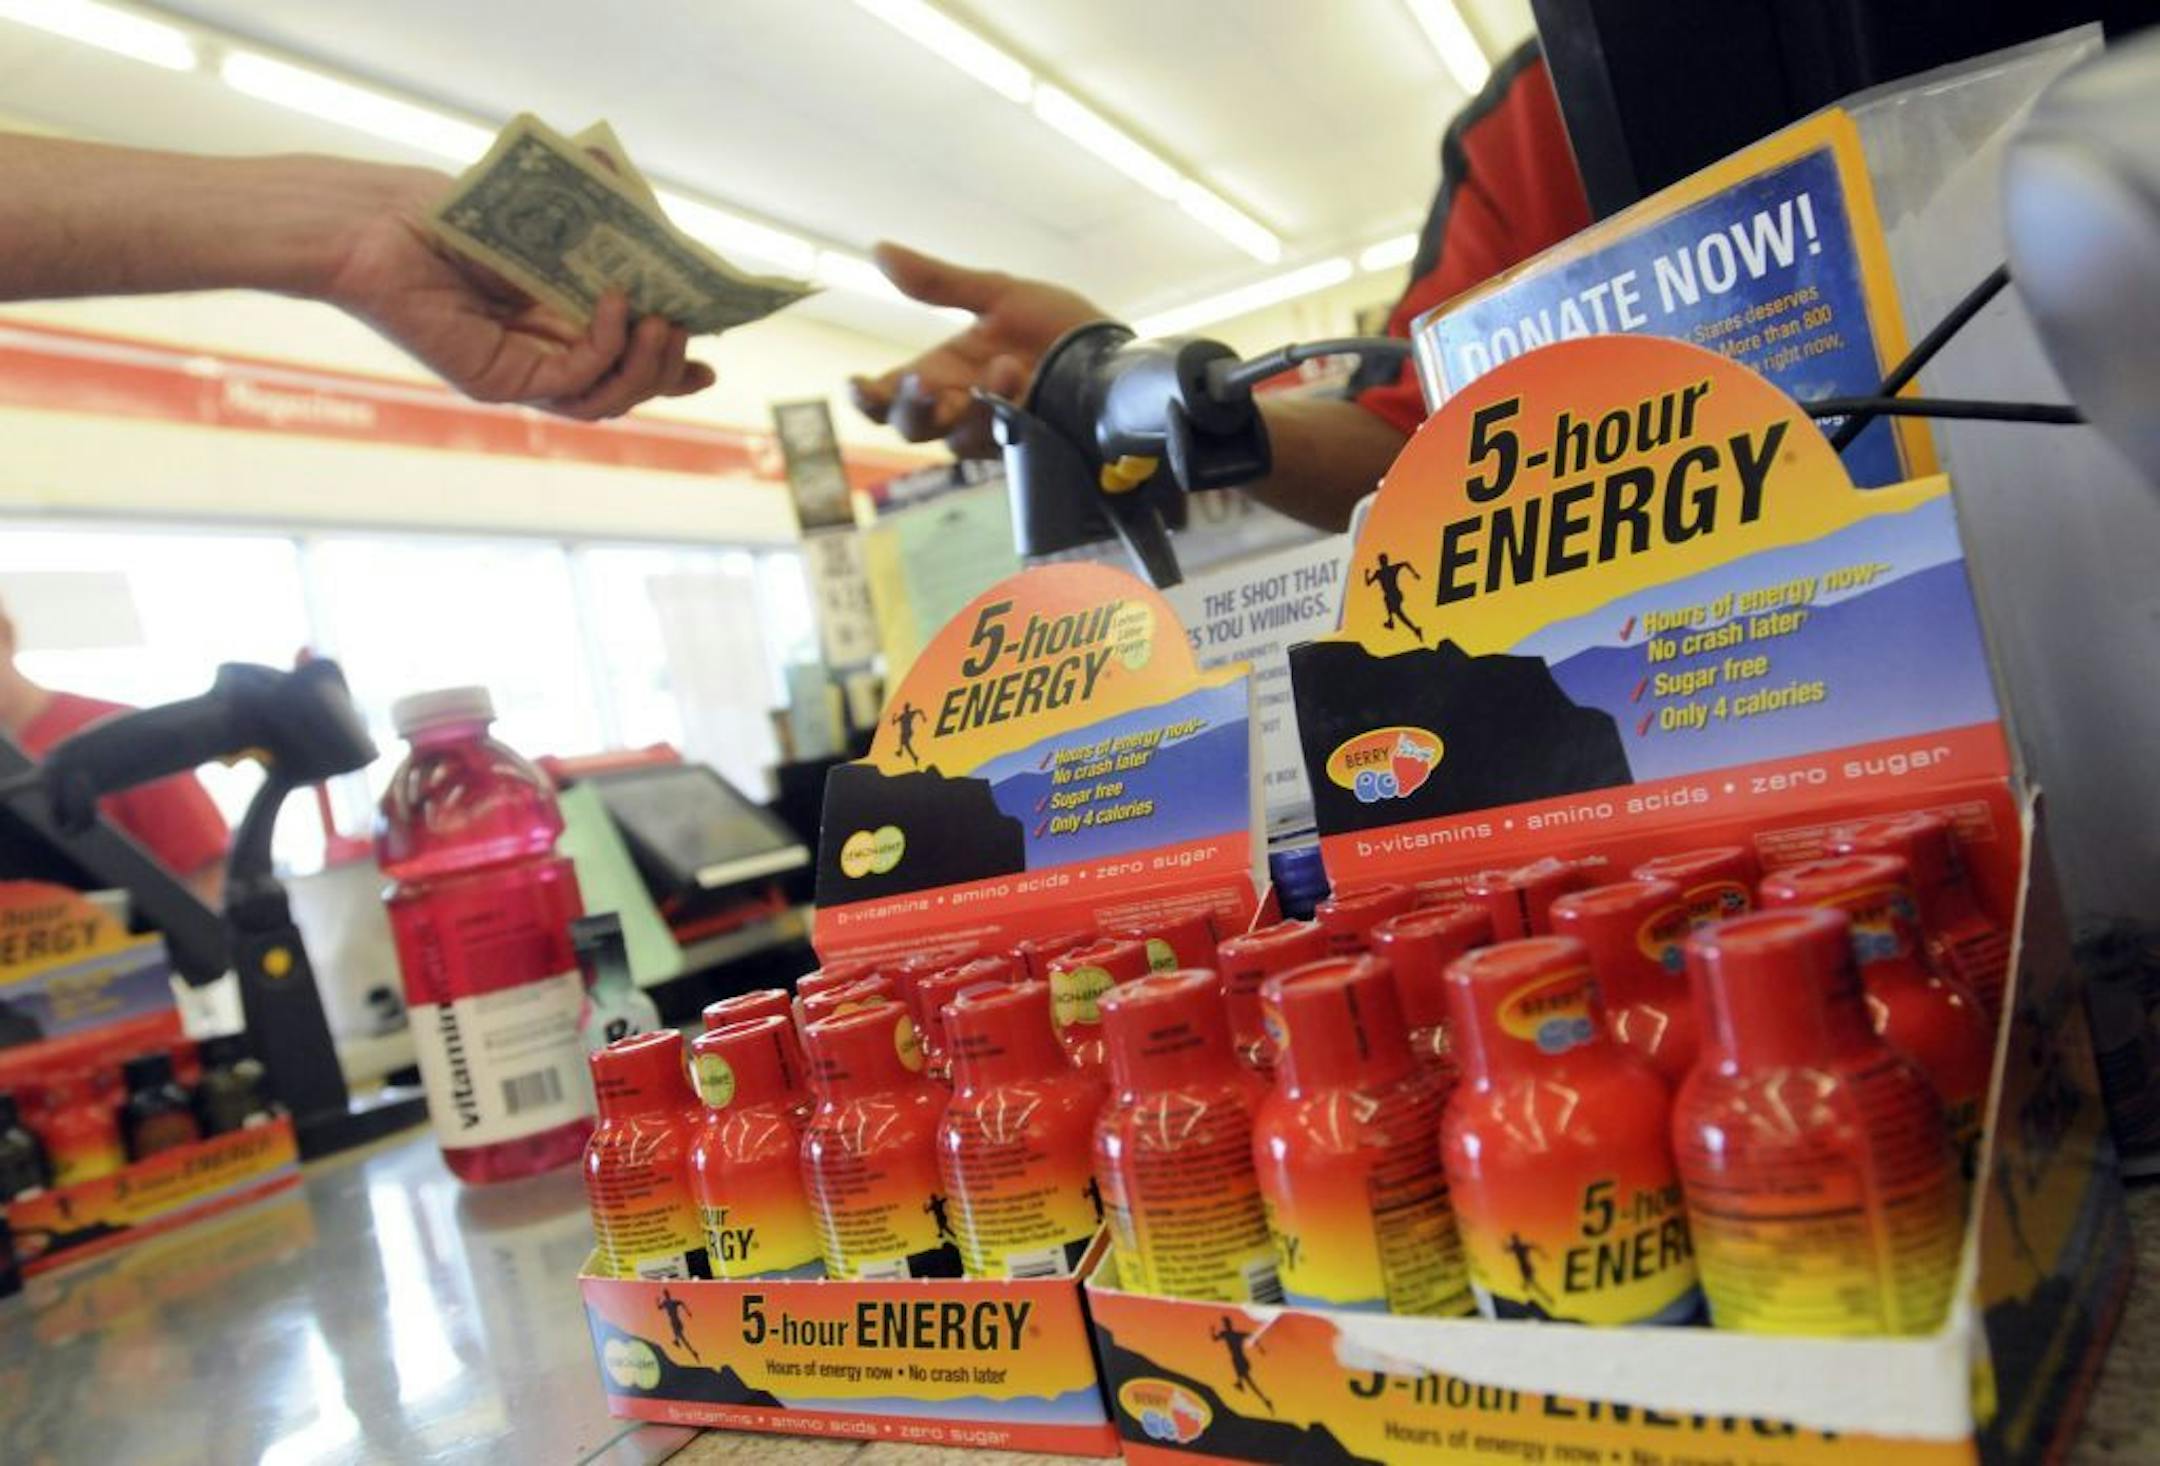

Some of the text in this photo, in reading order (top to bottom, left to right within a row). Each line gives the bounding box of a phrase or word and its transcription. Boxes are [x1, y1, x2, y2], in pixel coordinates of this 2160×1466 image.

[1461, 193, 1822, 379] DONATE NOW!
[1746, 284, 1820, 323] deserves
[1719, 330, 1761, 354] More
[1763, 319, 1801, 344] than
[1764, 342, 1801, 372] right
[1464, 378, 1712, 503] 5-hour
[1435, 419, 1791, 608] ENERGY
[1203, 558, 1341, 619] THE SHOT THAT
[1642, 603, 1707, 637] Hours
[1712, 591, 1734, 619] of
[1740, 576, 1817, 612] energy
[961, 600, 1125, 679] 5-hour
[1207, 615, 1244, 645] YOU
[1648, 637, 1678, 664] No
[1682, 622, 1745, 658] crash
[934, 645, 1115, 739] ENERGY
[1653, 655, 1770, 698] Sugar free
[1660, 680, 1826, 733] Only 4 calories
[1113, 728, 1164, 752] energy
[1345, 745, 1390, 770] BERRY
[1053, 768, 1073, 785] No
[1074, 760, 1113, 781] crash
[1050, 799, 1155, 835] Only 4 calories
[1051, 781, 1125, 810] Sugar free
[1356, 745, 1952, 858] b-vitamins amino acids zero sugar
[952, 883, 1010, 907] amino
[1016, 872, 1071, 896] acids
[1096, 859, 1145, 880] zero
[1152, 844, 1219, 869] sugar
[1564, 1215, 1696, 1294] ENER
[741, 1294, 1032, 1351] 5-hour ENERGY
[766, 1359, 801, 1376] Hours
[803, 1360, 817, 1375] of
[819, 1363, 862, 1383] energy
[864, 1366, 893, 1380] now
[908, 1364, 928, 1381] No
[931, 1365, 970, 1383] crash
[830, 1418, 878, 1436] acids
[900, 1423, 945, 1440] zero
[950, 1427, 1012, 1445] sugar
[1385, 1419, 1443, 1449] Hours
[1448, 1427, 1468, 1449] of
[1473, 1431, 1548, 1461] energy
[1553, 1442, 1603, 1464] now
